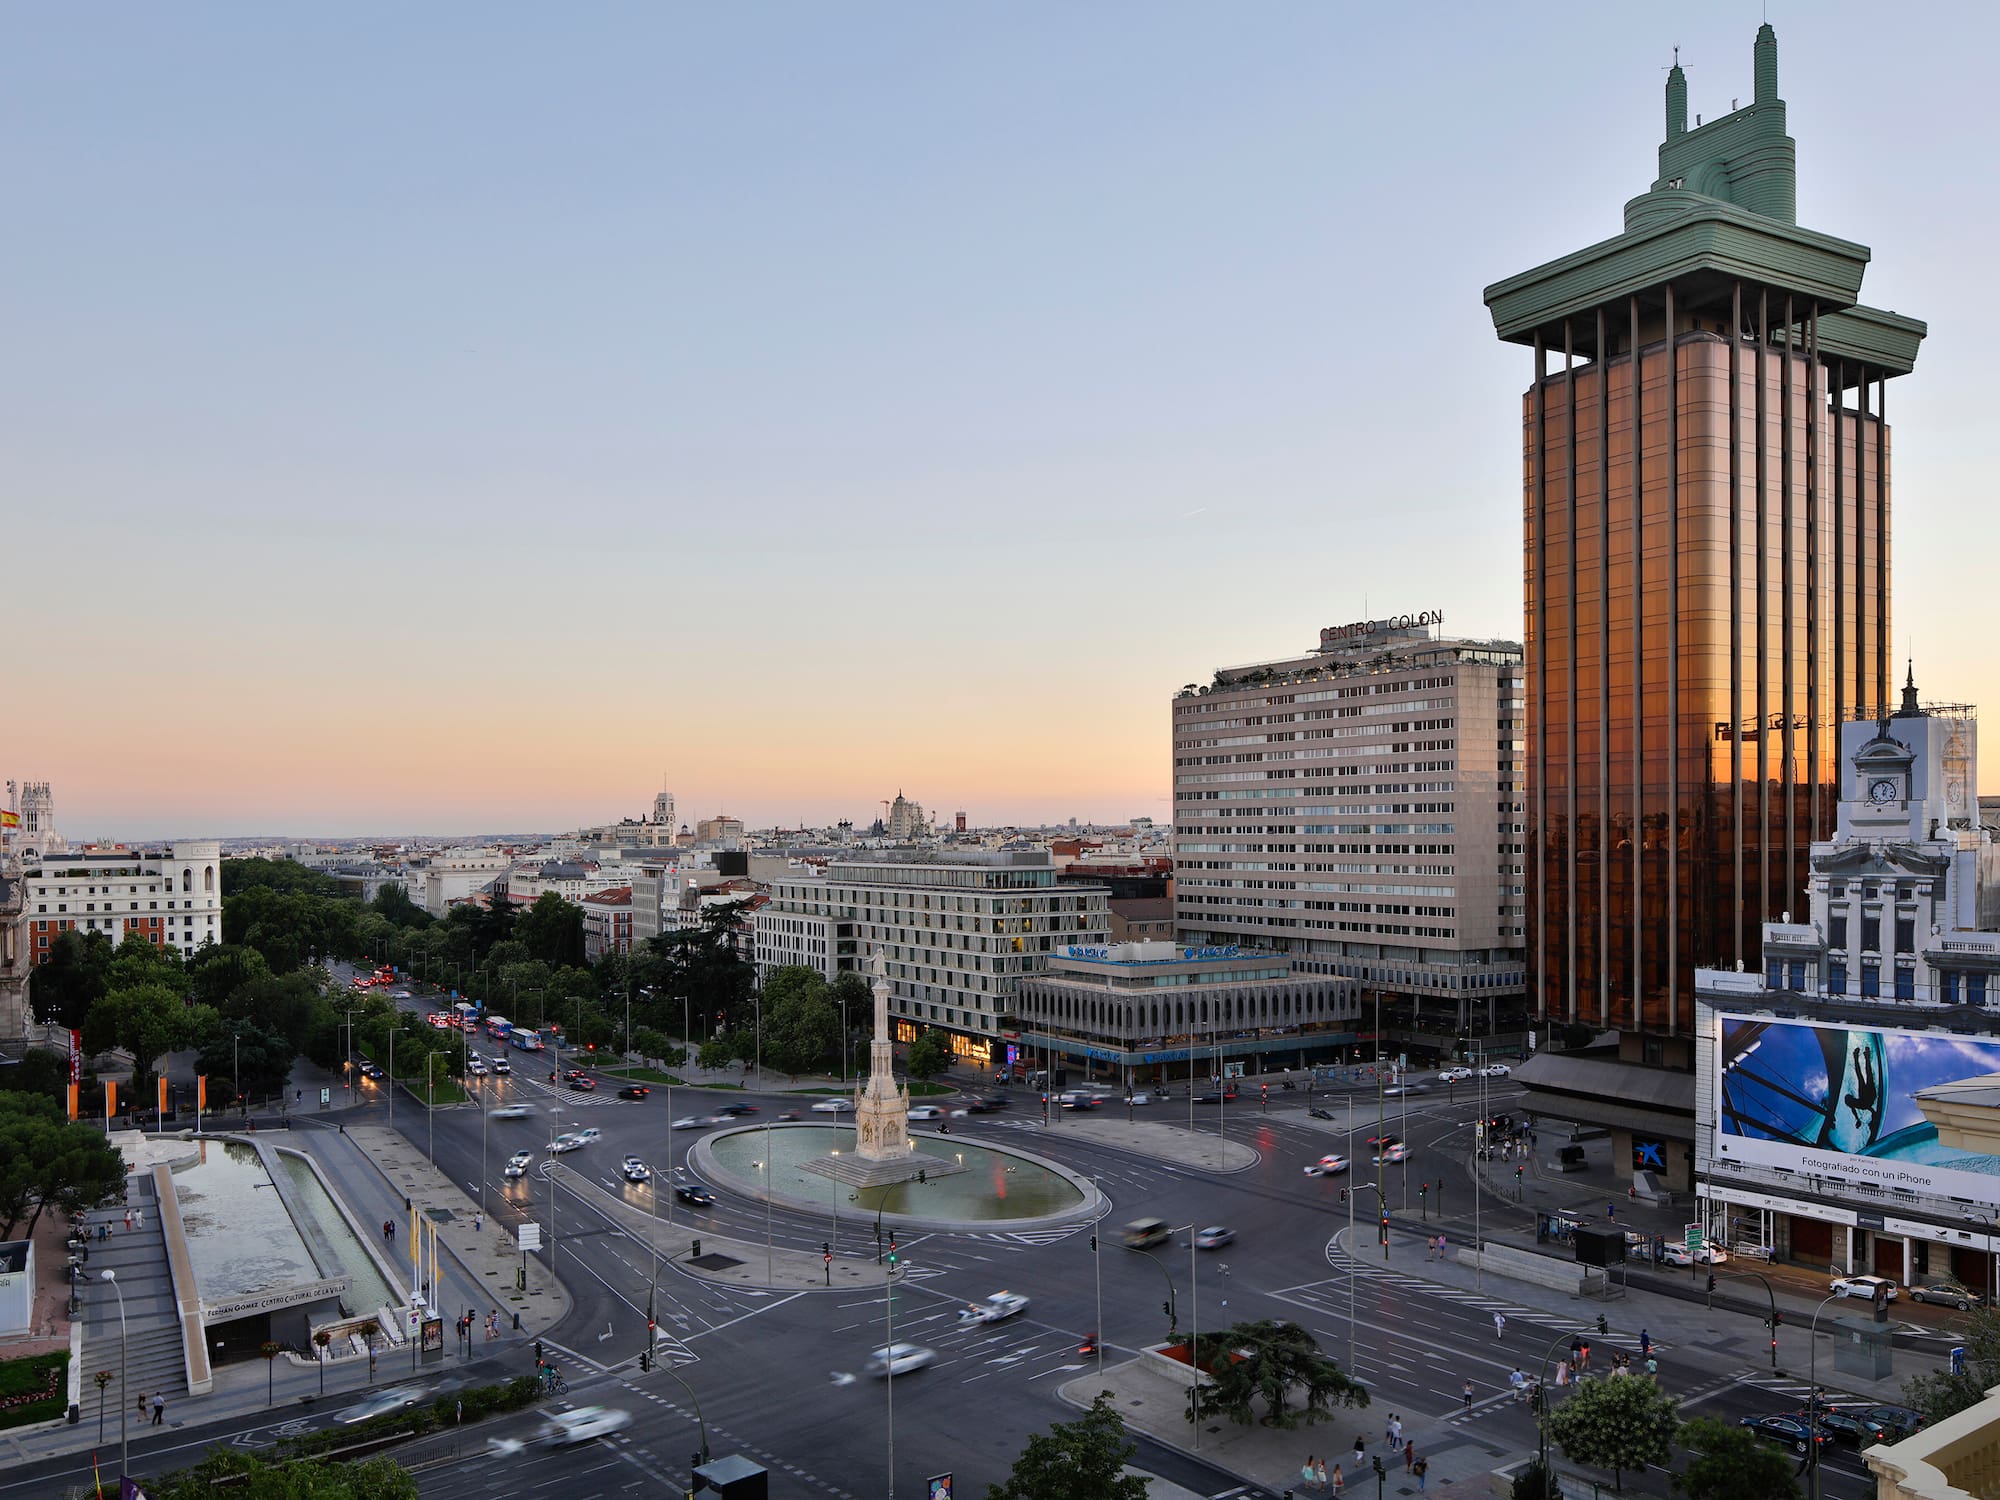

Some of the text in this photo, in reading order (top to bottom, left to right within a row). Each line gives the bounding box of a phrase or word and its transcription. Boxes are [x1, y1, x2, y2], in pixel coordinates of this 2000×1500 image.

[1319, 620, 1376, 642] CENTRO
[1801, 1156, 1861, 1175] Fotografiado
[1861, 1166, 1881, 1178] con
[1882, 1170, 1896, 1180] un
[1897, 1172, 1932, 1186] iPhone
[261, 1296, 284, 1308] CENTRO
[284, 1292, 313, 1304] CULTURAL
[329, 1284, 347, 1295] VILLA
